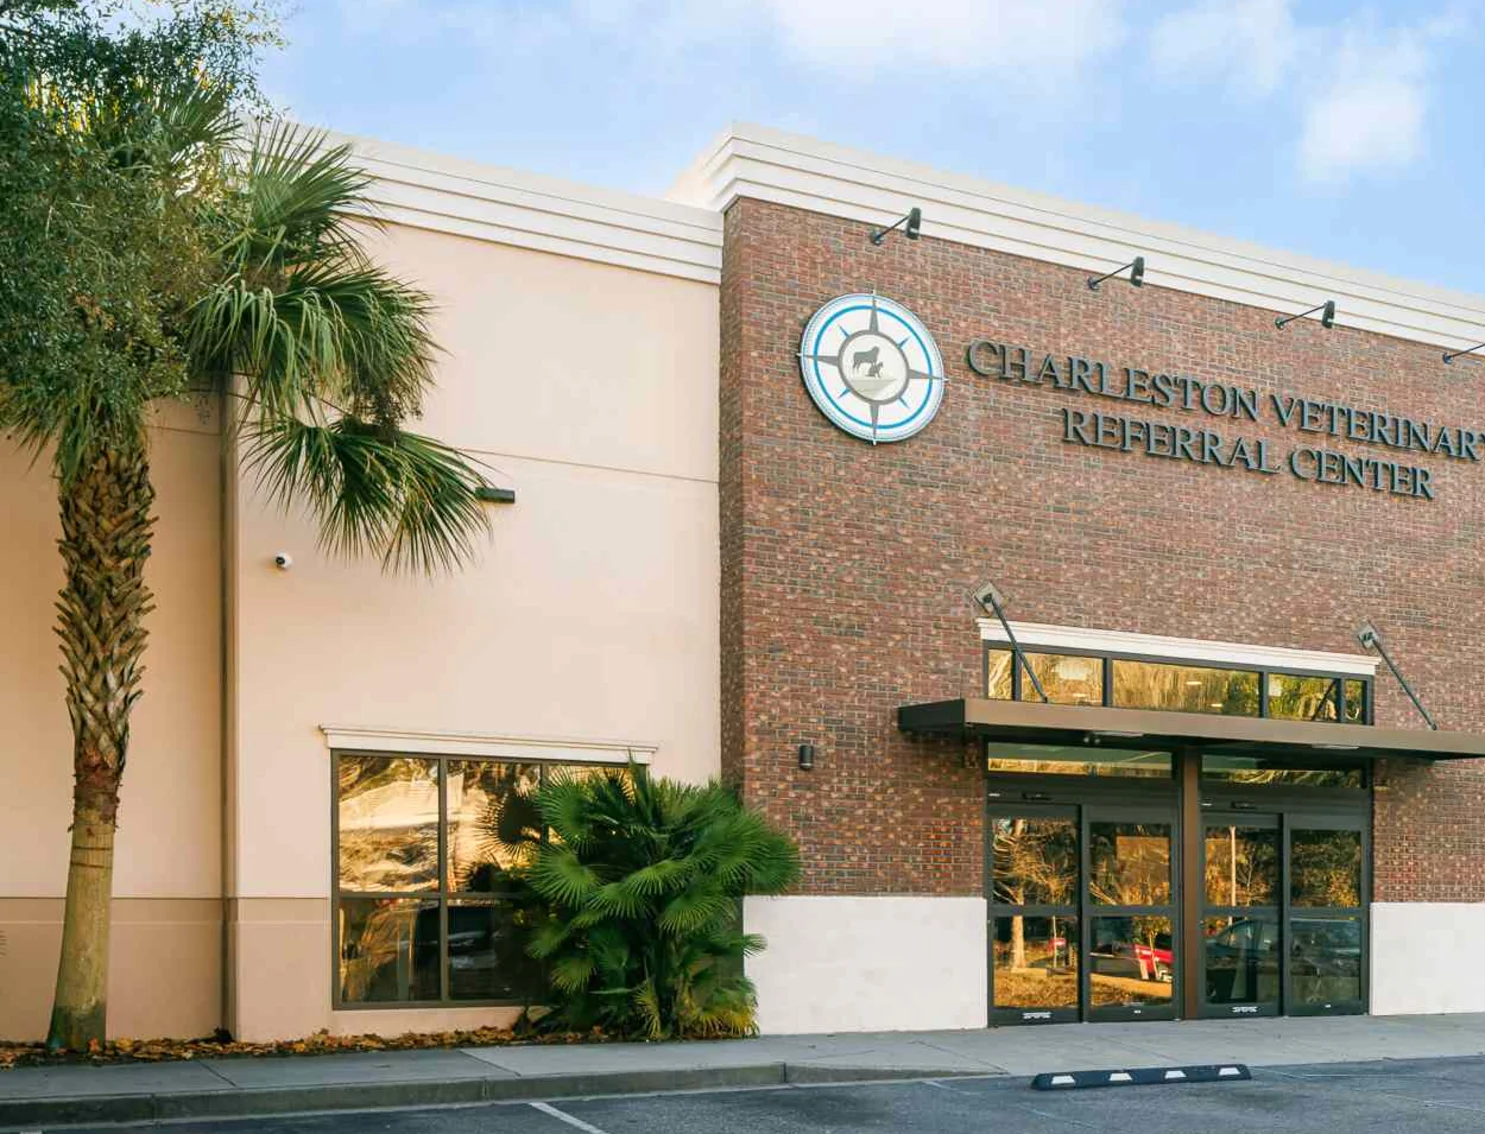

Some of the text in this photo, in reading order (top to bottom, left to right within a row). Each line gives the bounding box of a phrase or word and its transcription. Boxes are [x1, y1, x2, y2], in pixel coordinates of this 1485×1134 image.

[967, 340, 1259, 421] CHARLESTON
[1062, 407, 1434, 499] REFERRAL CENTER
